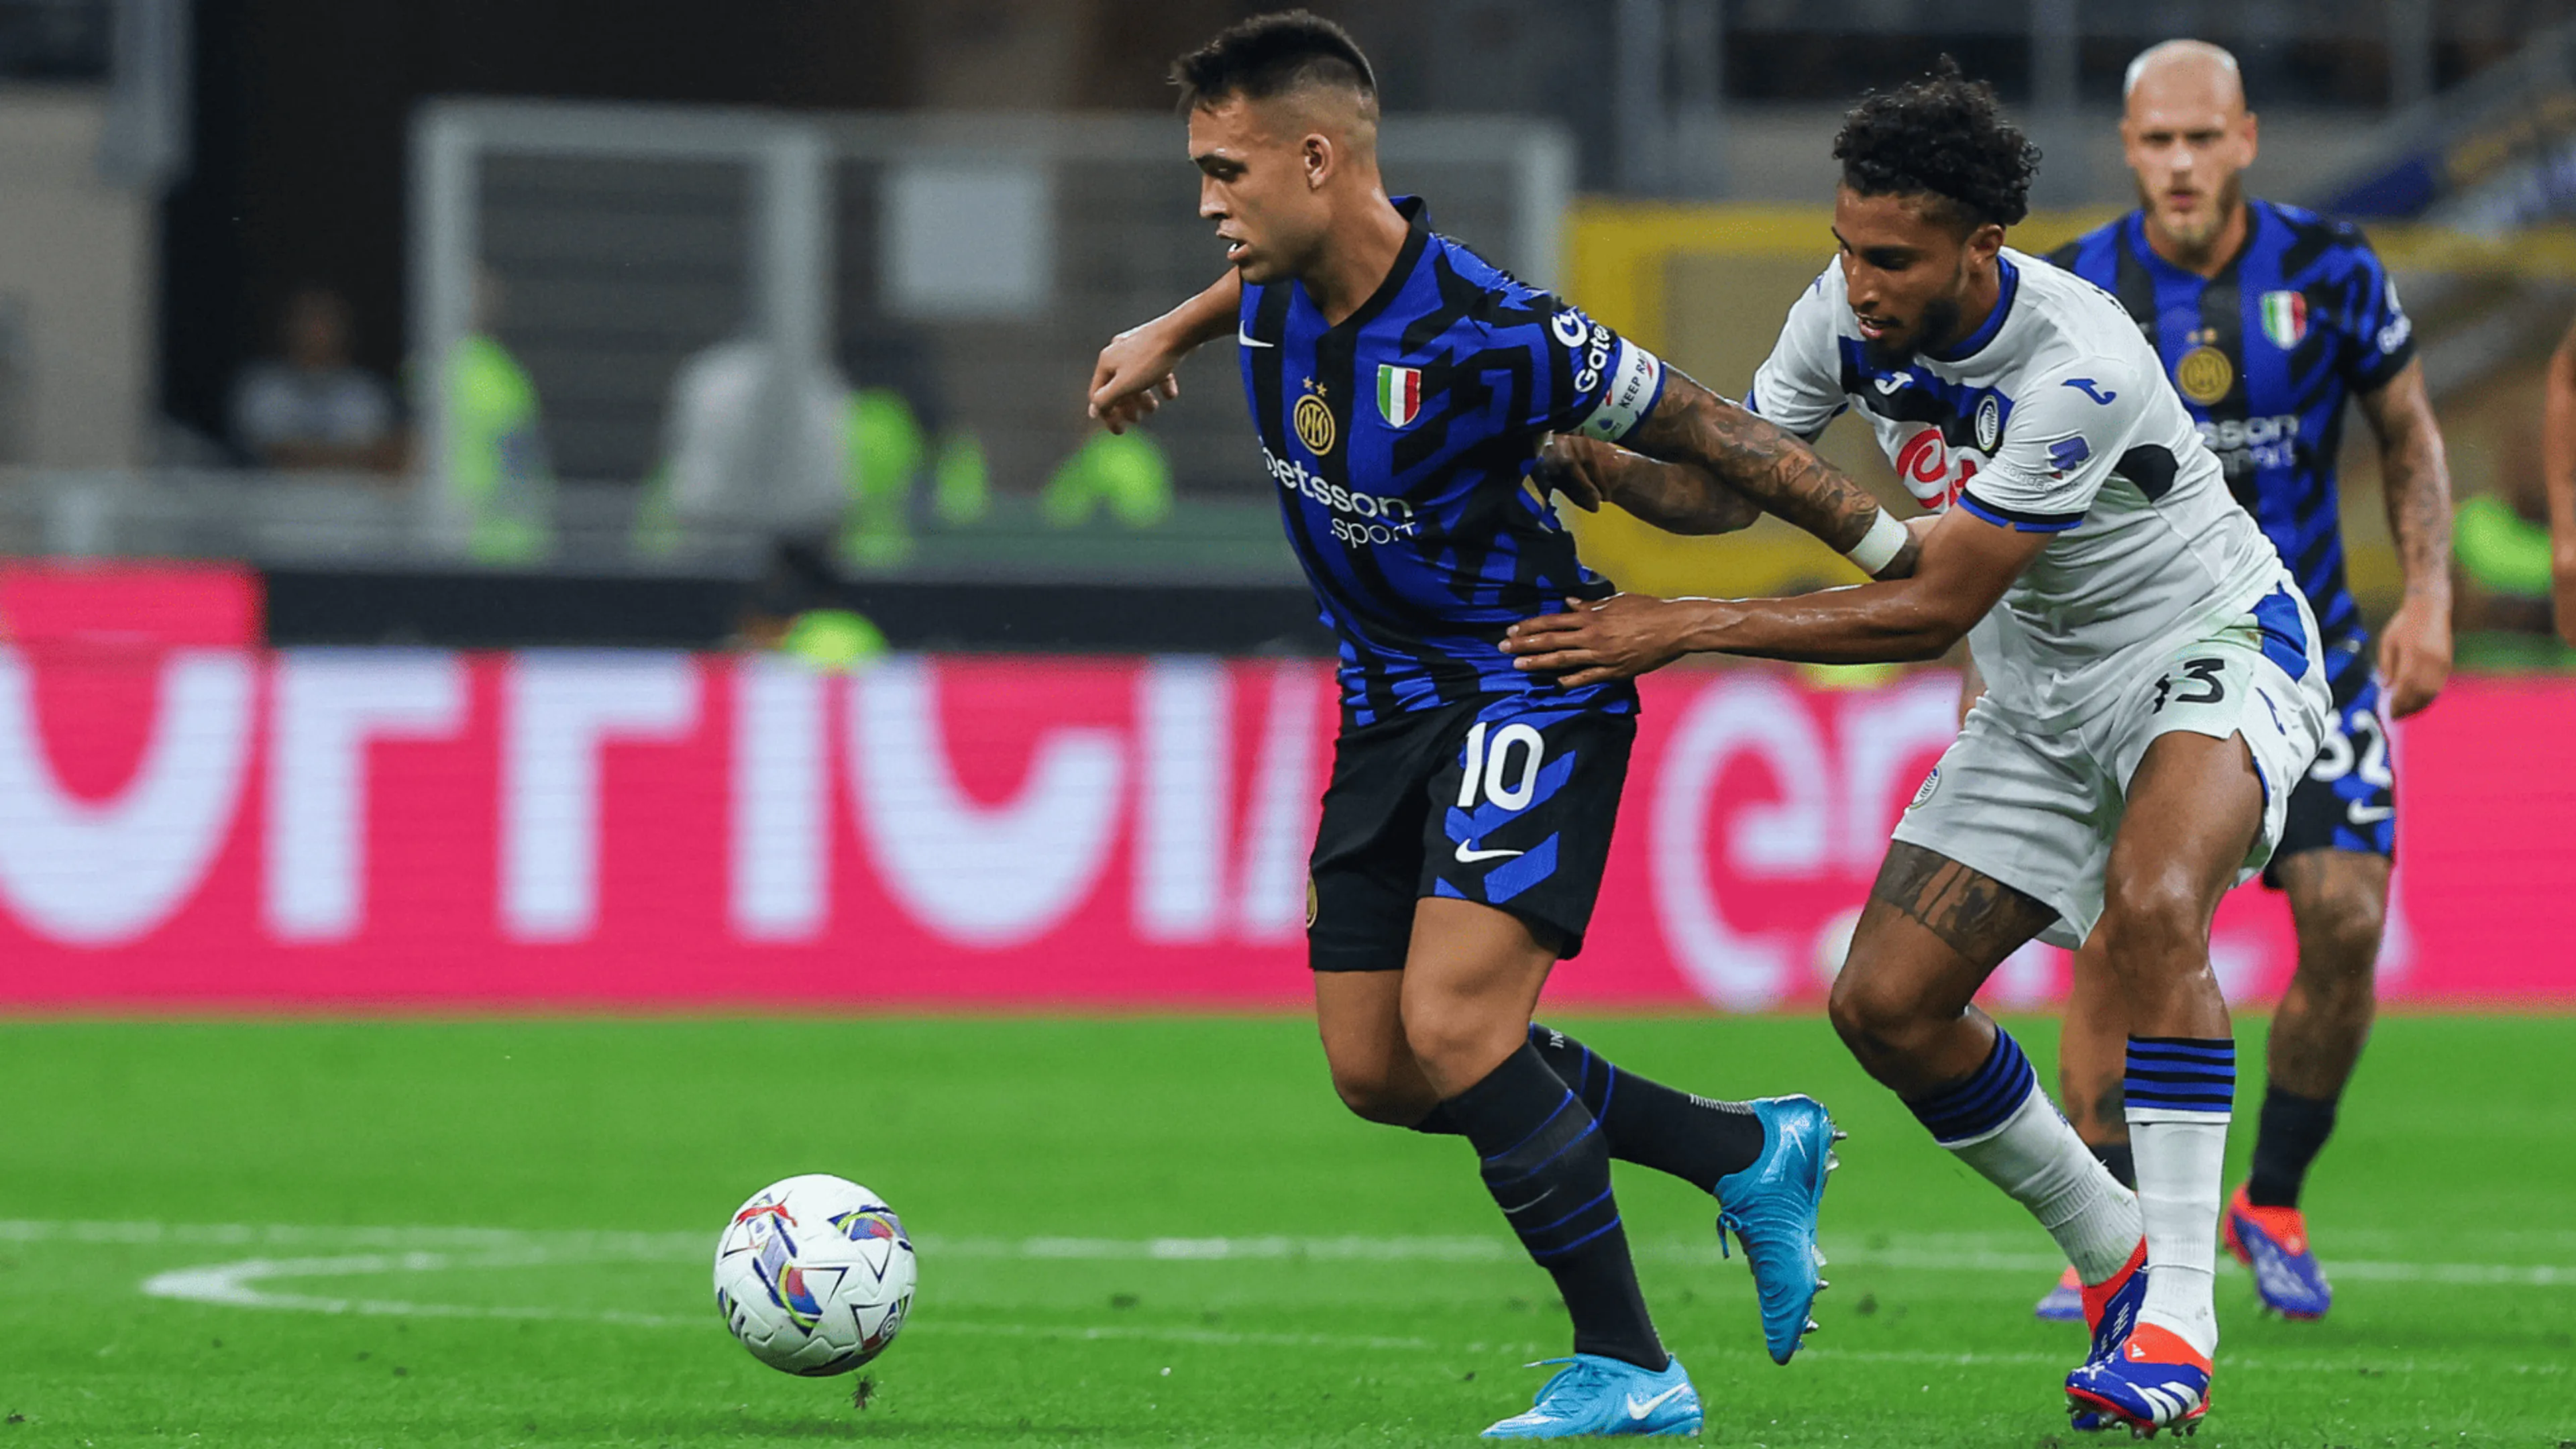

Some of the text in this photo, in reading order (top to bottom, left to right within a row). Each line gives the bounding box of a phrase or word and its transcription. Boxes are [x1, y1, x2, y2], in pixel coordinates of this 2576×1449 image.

[1618, 376, 1642, 409] KEEP
[2151, 658, 2225, 715] 13
[1456, 720, 1545, 812] 10
